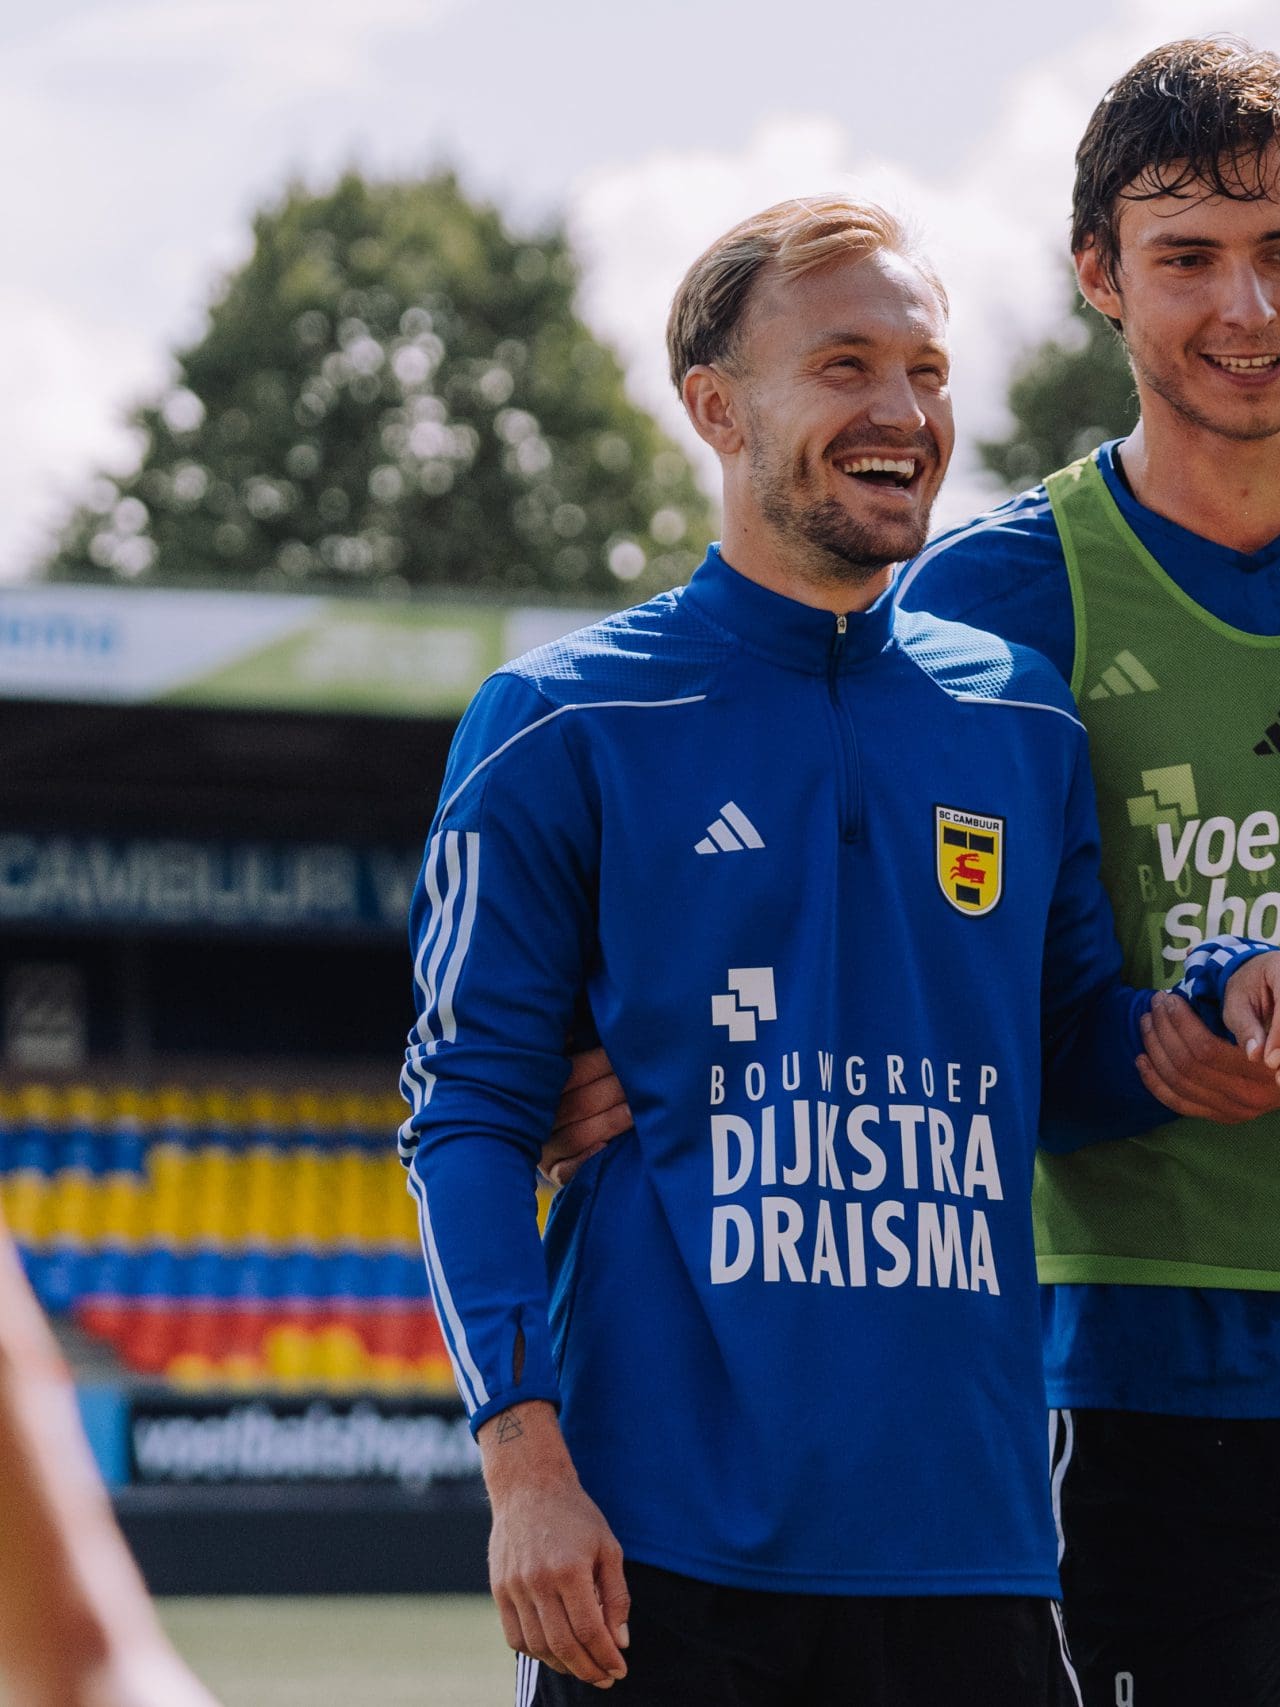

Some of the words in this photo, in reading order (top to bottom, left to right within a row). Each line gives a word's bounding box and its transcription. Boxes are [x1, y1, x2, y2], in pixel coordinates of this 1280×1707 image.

[939, 810, 951, 820] SC
[953, 813, 1000, 831] CAMBUUR
[710, 1050, 998, 1105] BOUWGROEP
[710, 1099, 1004, 1201] DIJKSTRA
[710, 1197, 1000, 1296] DRAISMA
